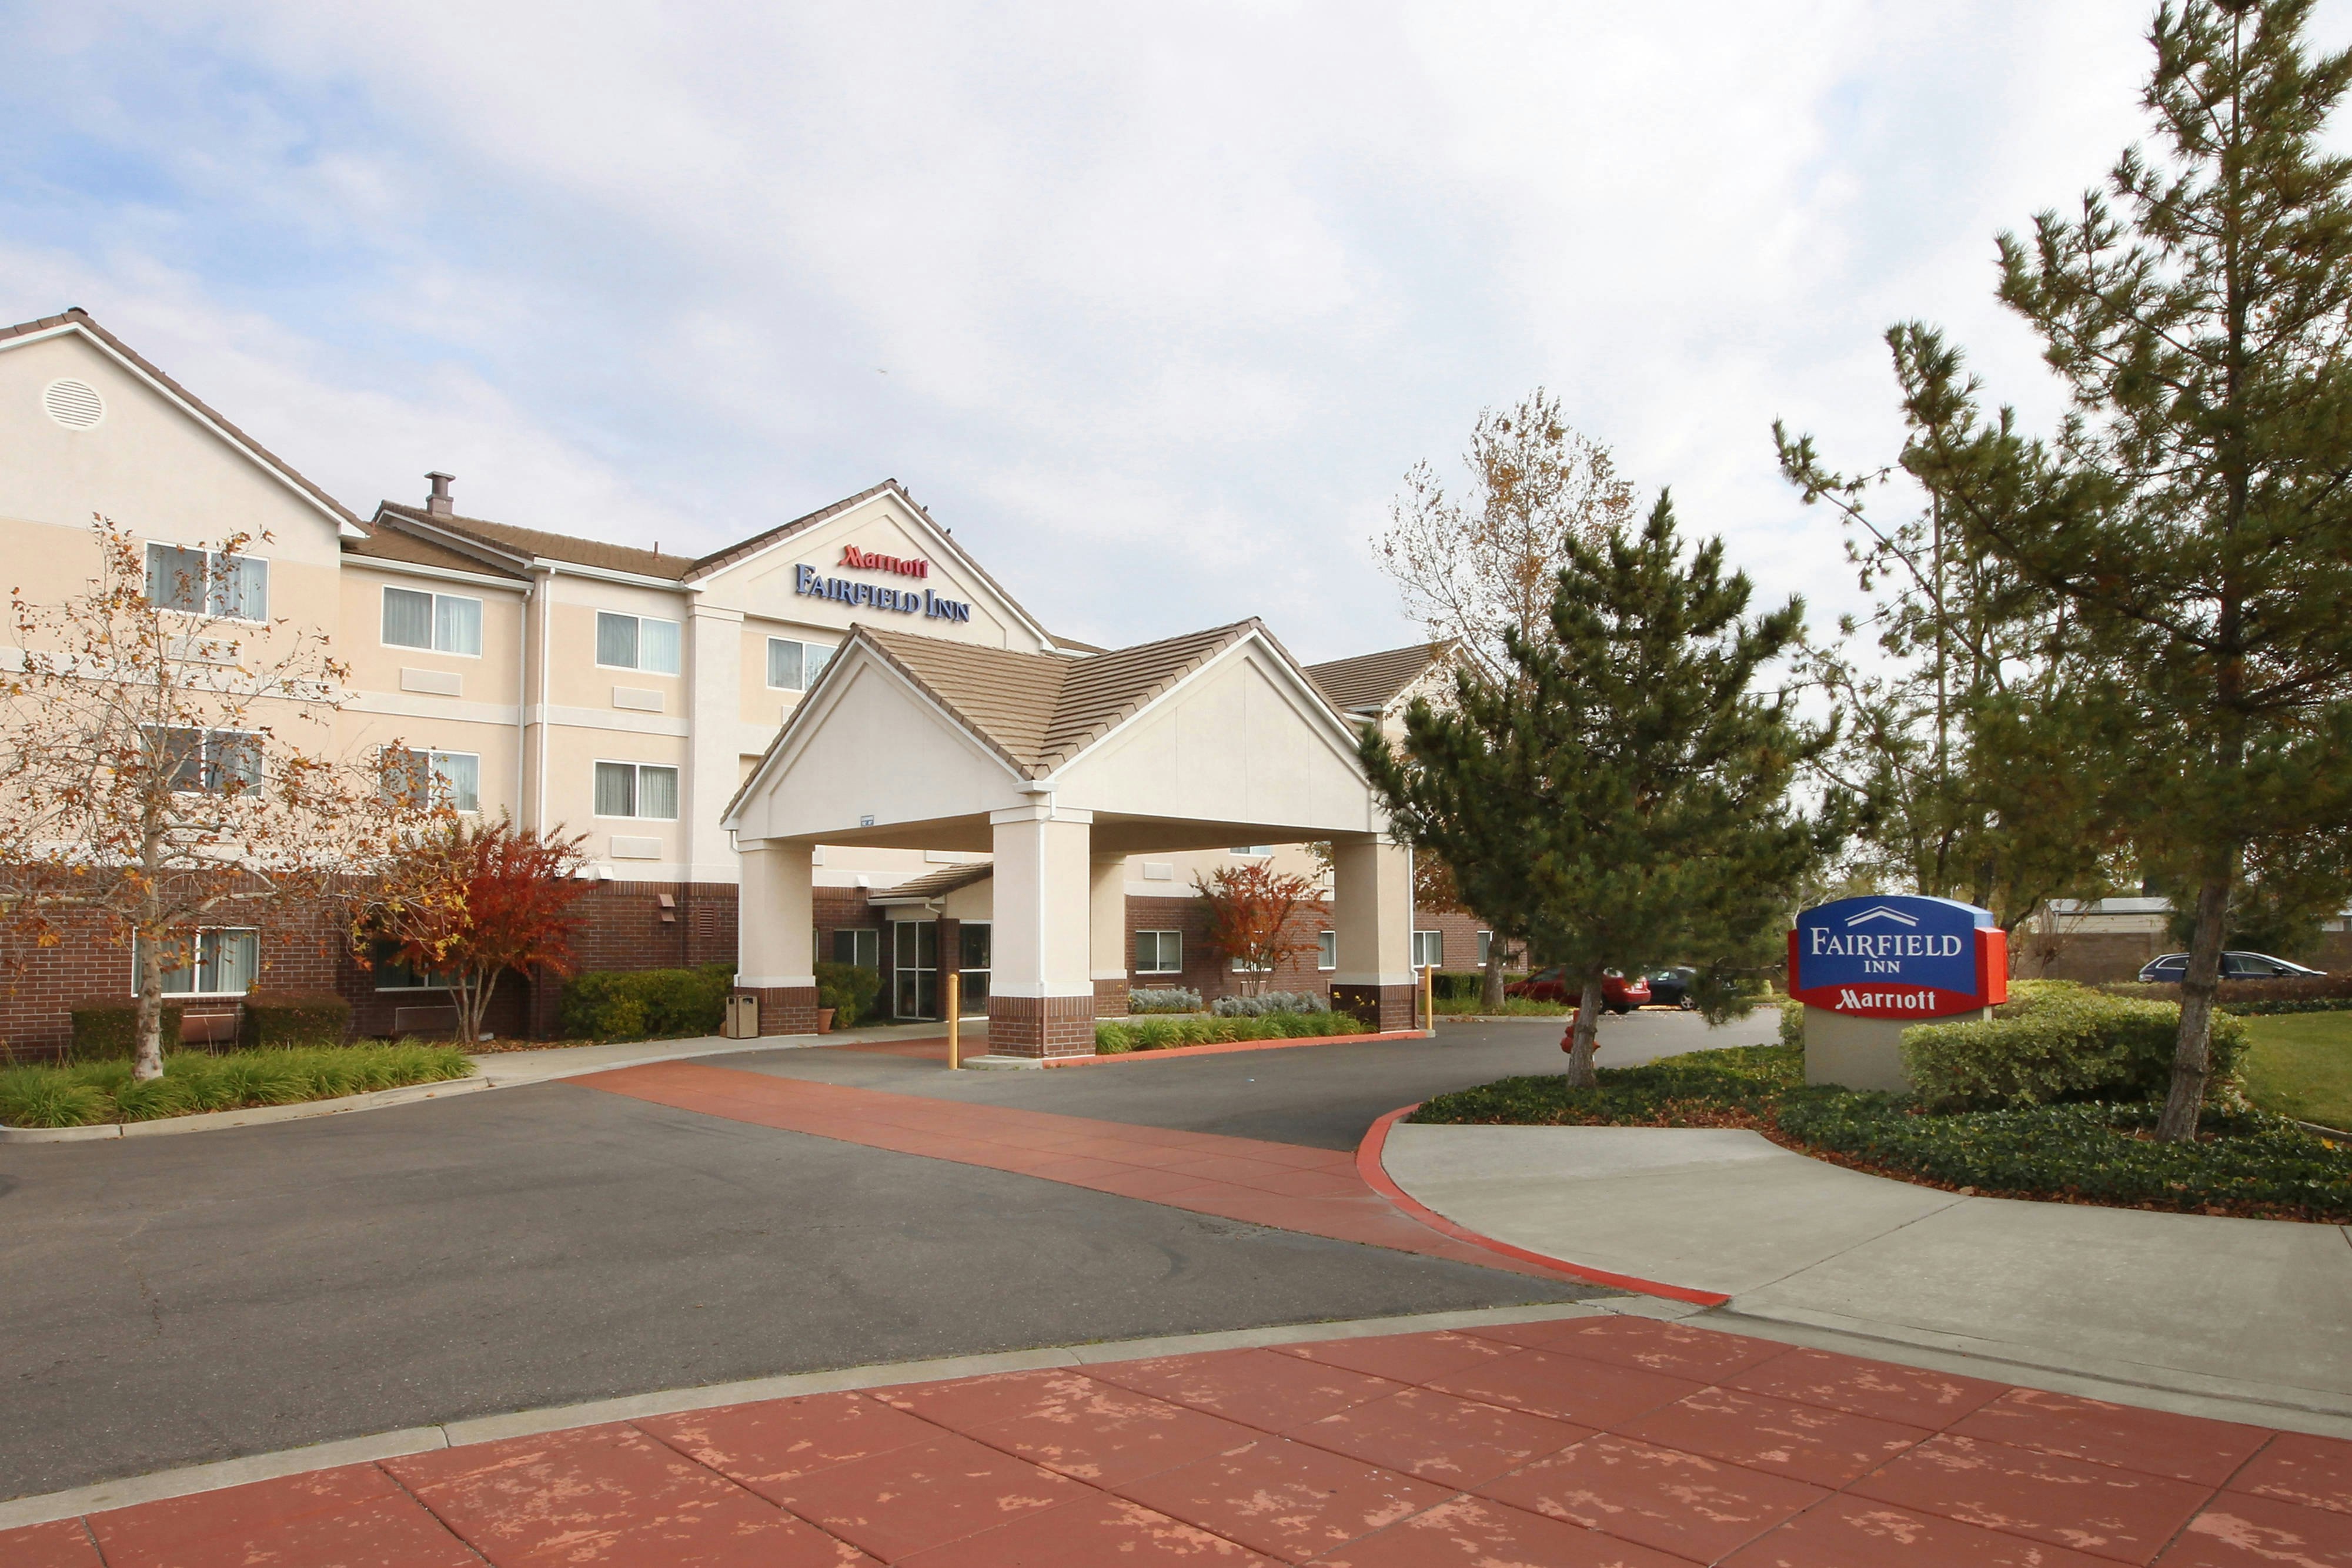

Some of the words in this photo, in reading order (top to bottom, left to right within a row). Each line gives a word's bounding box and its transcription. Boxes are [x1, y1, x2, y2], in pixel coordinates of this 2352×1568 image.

[838, 544, 929, 579] Marriott
[794, 563, 923, 613] FAIRFIELD
[924, 587, 971, 623] INN
[1810, 927, 1962, 958] FAIRFIELD
[1864, 960, 1900, 974] INN
[1835, 988, 1936, 1010] Marriott
